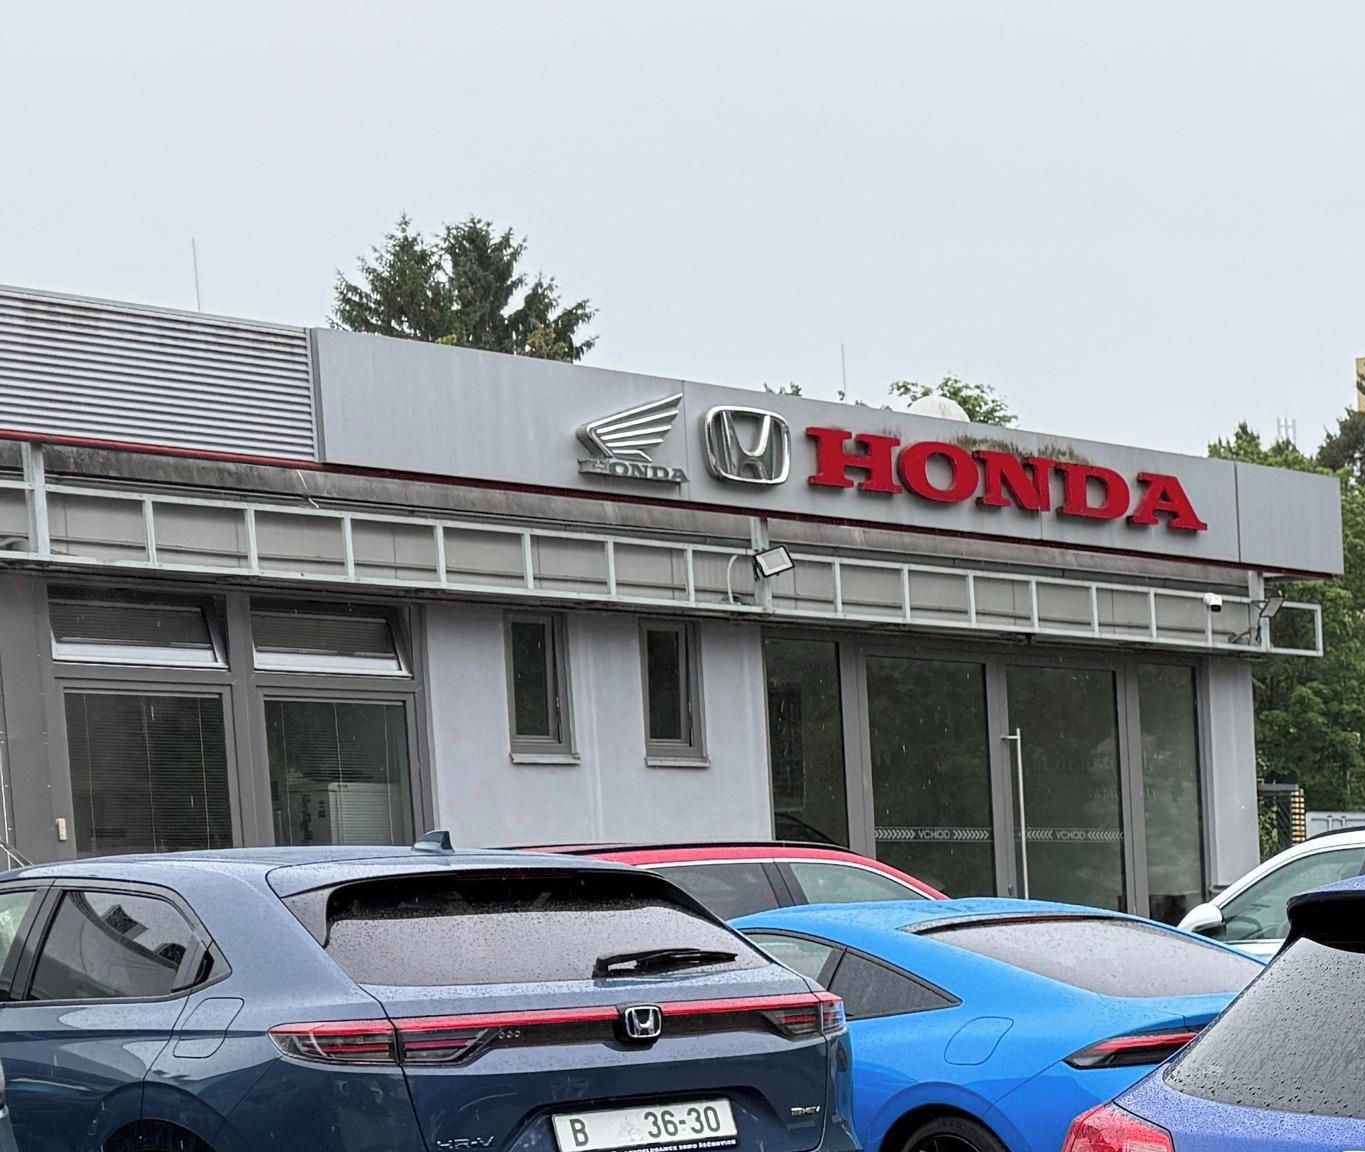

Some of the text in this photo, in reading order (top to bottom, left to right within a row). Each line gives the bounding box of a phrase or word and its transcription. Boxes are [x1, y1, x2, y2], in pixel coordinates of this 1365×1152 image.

[578, 458, 689, 484] HONDA
[806, 425, 1208, 531] HONDA
[918, 830, 951, 840] VCHOD
[1055, 830, 1086, 841] VCHOD
[569, 1105, 721, 1147] B 36-30
